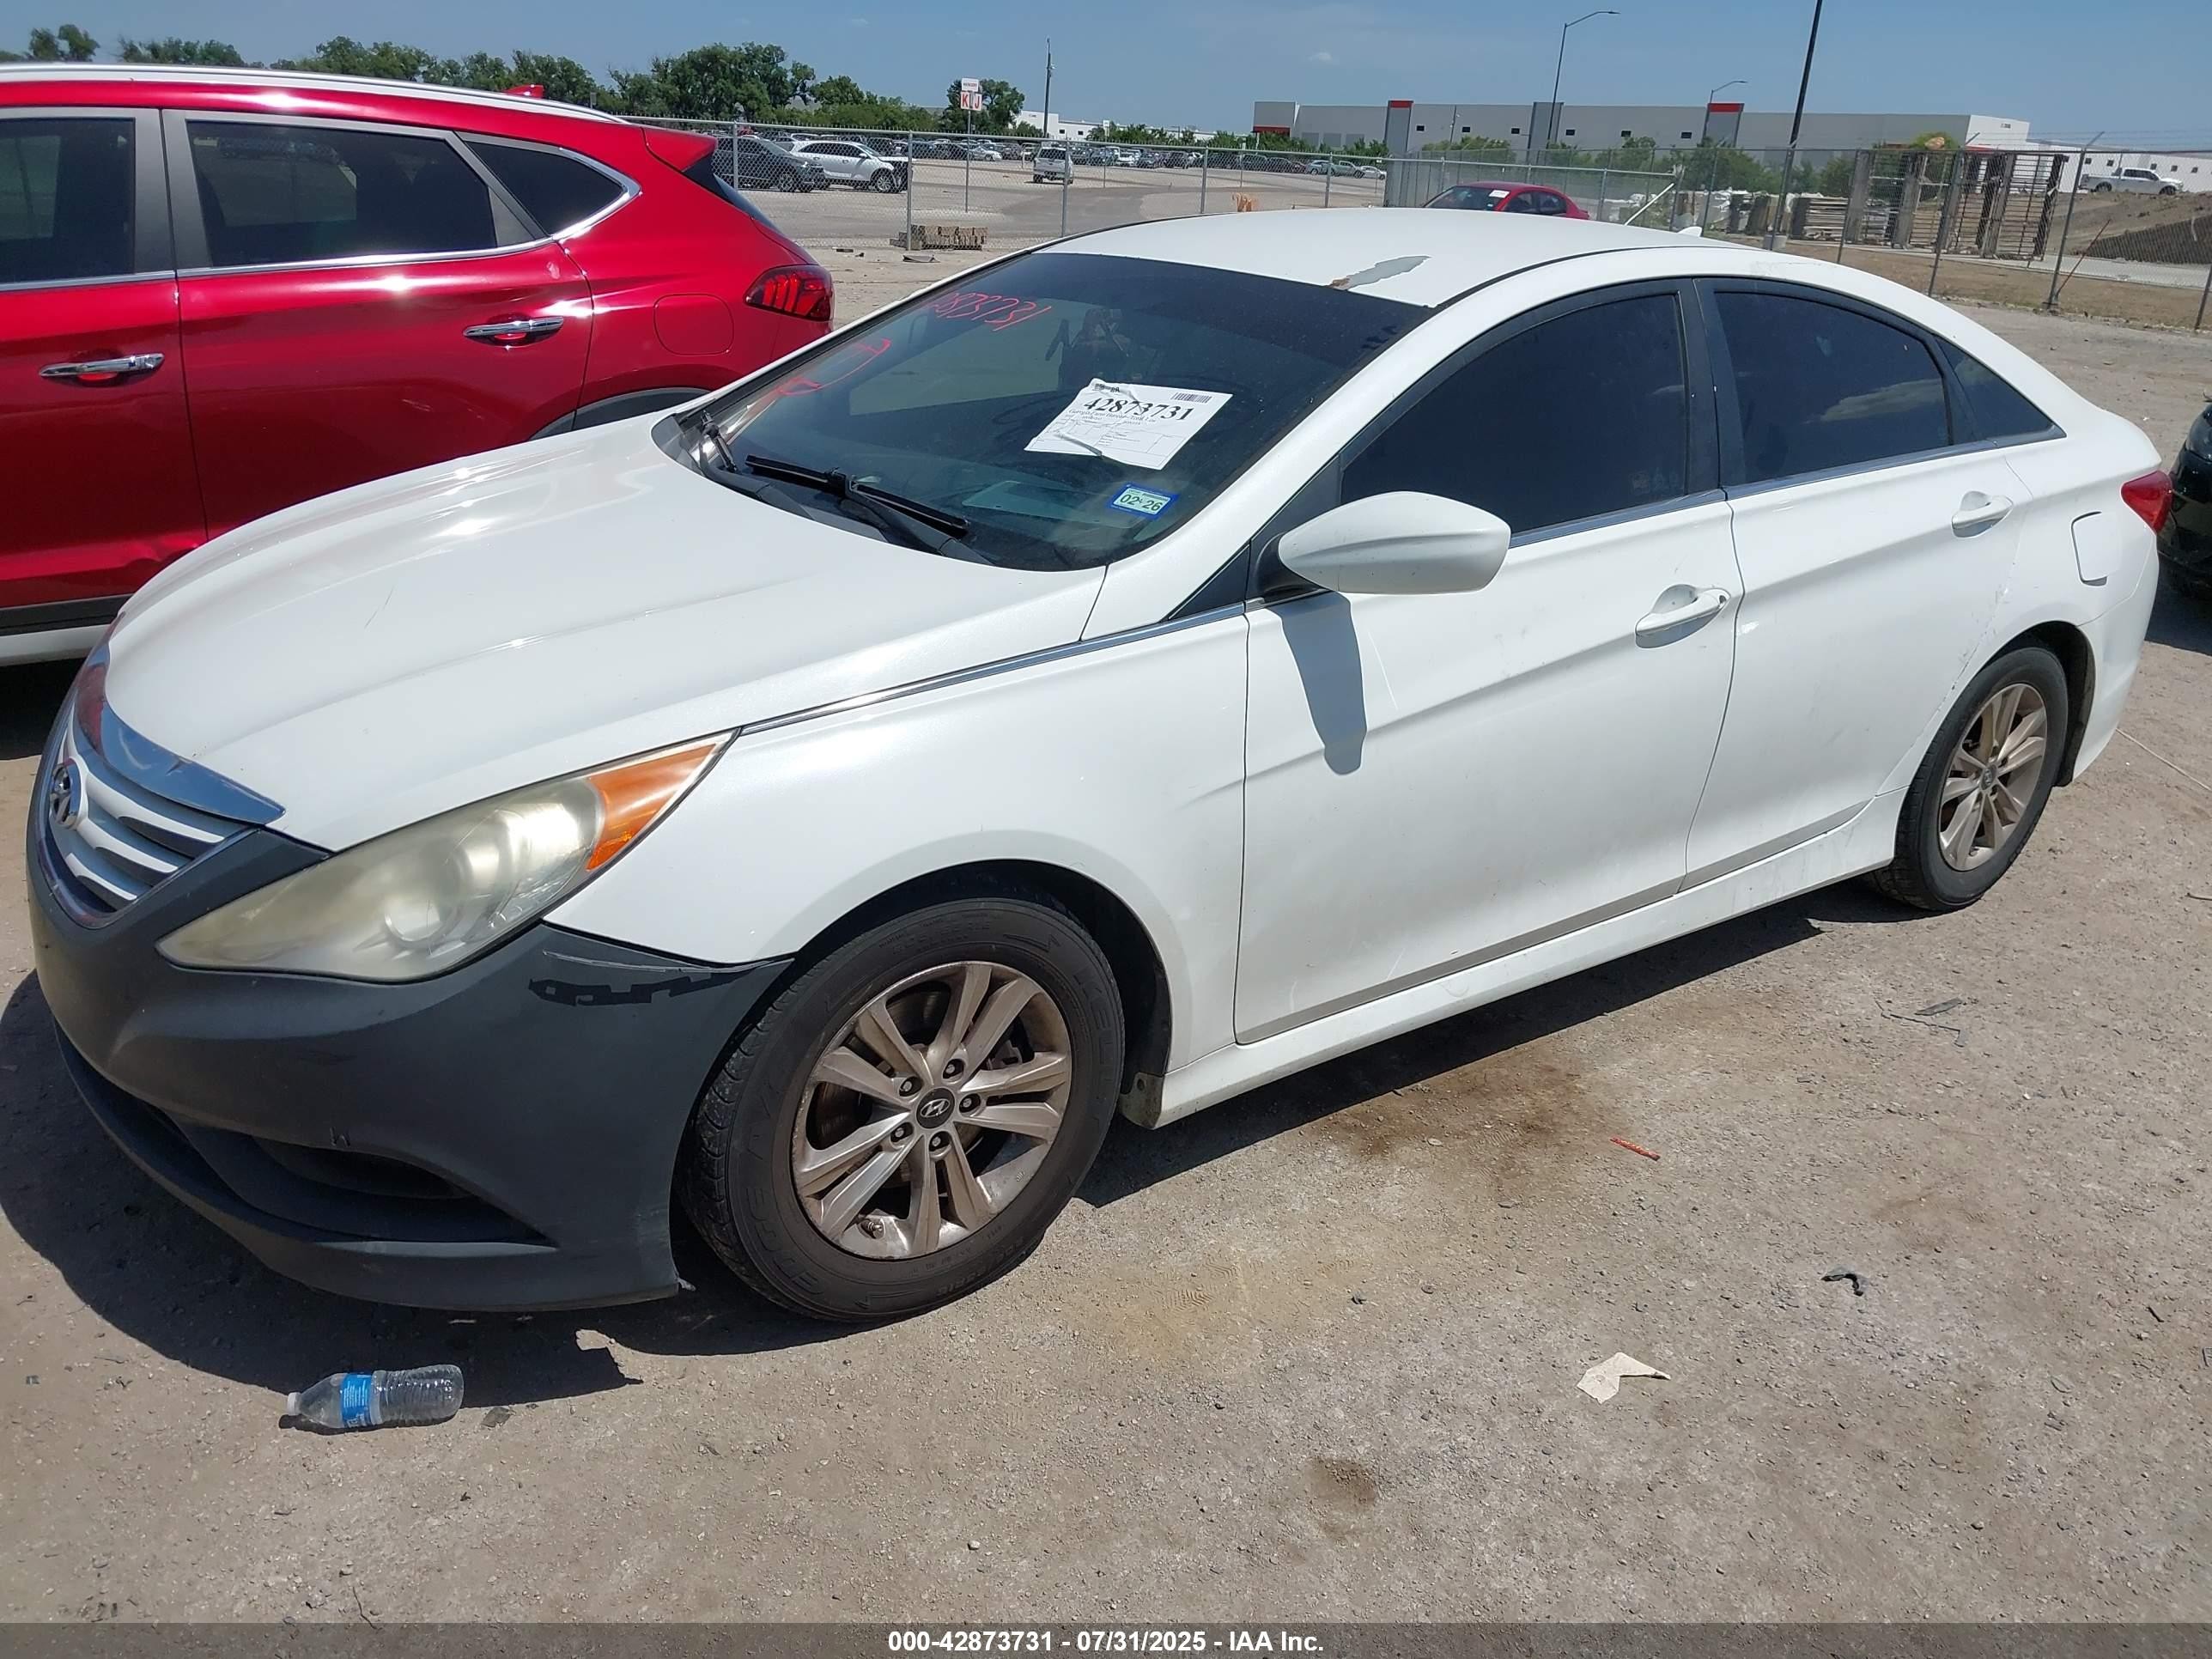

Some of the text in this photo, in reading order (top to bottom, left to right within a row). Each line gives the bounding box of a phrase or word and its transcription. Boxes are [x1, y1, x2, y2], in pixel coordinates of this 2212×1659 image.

[962, 93, 969, 108] K
[974, 95, 981, 109] J
[1083, 397, 1195, 421] 42873731
[1141, 500, 1163, 511] 26
